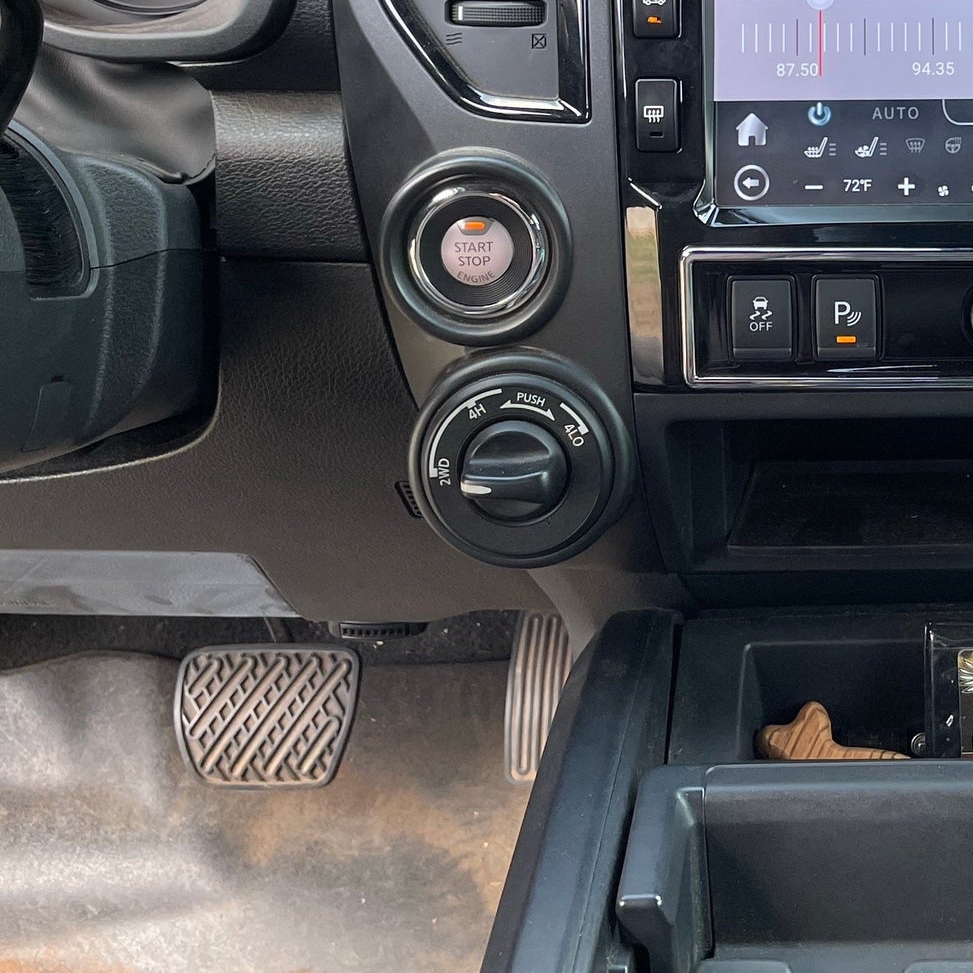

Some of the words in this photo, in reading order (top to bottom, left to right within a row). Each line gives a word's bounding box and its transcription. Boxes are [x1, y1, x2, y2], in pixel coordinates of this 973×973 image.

[776, 62, 819, 77] 87.50
[911, 61, 955, 76] 94.35
[872, 106, 920, 121] AUTO
[454, 240, 494, 254] START
[458, 254, 491, 268] STOP
[457, 270, 496, 284] ENGINE
[834, 301, 850, 324] P
[749, 320, 774, 332] OFF
[516, 391, 546, 408] PUSH
[468, 405, 488, 420] 4H
[563, 422, 585, 449] 4LO
[438, 457, 452, 487] 2WD
